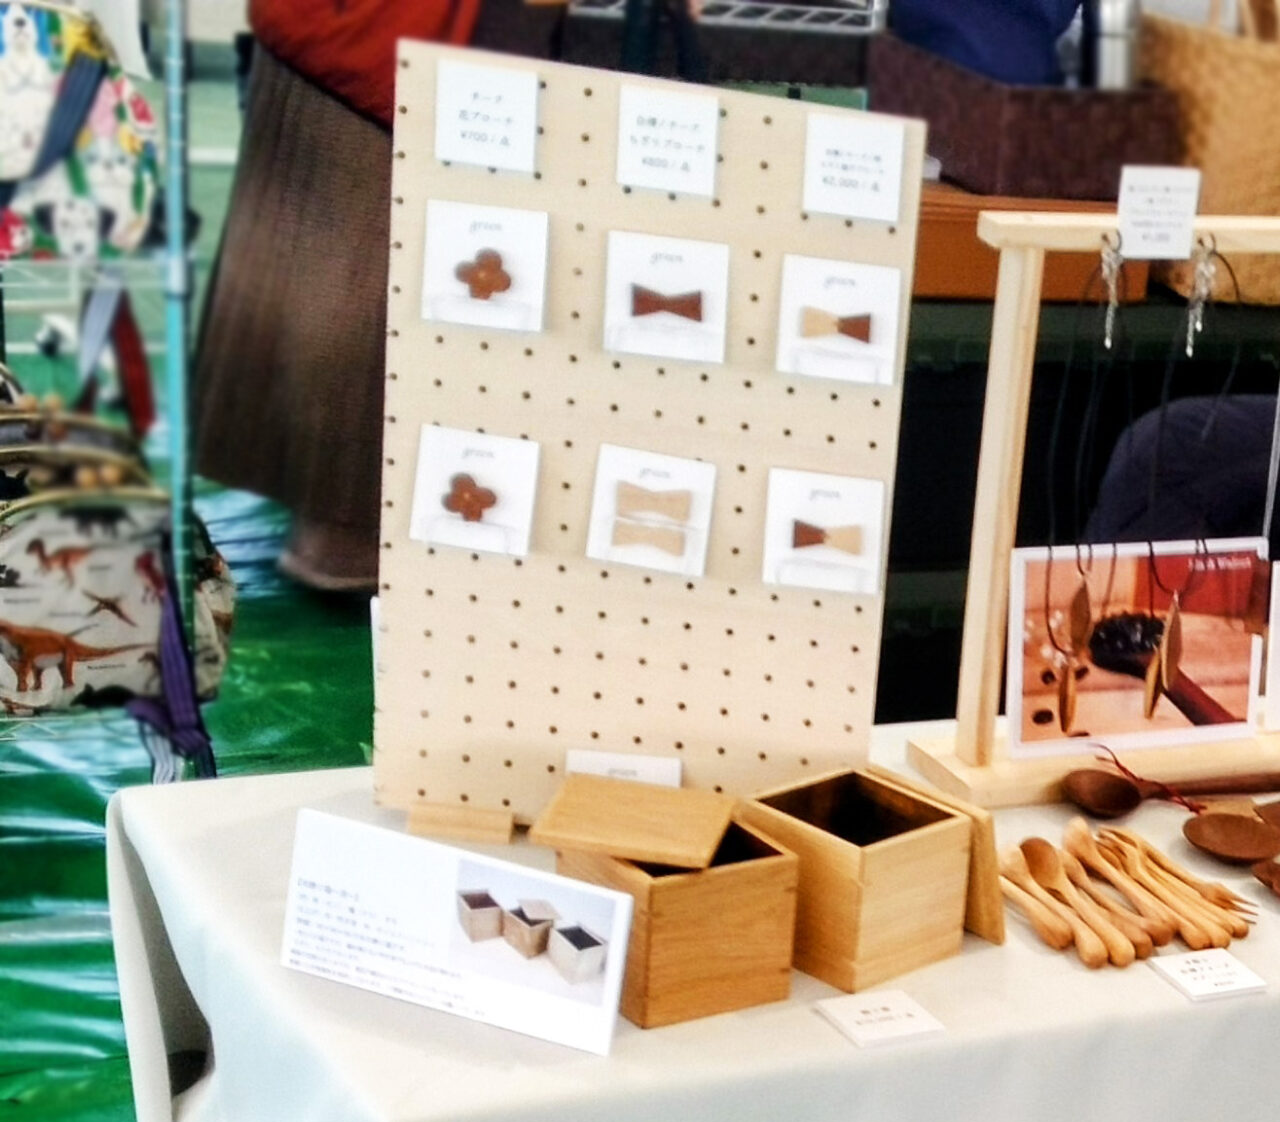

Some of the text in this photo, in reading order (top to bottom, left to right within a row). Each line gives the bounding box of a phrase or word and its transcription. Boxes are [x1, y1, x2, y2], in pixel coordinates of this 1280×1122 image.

[470, 218, 503, 235] green
[651, 249, 684, 266] green
[824, 274, 857, 291] green
